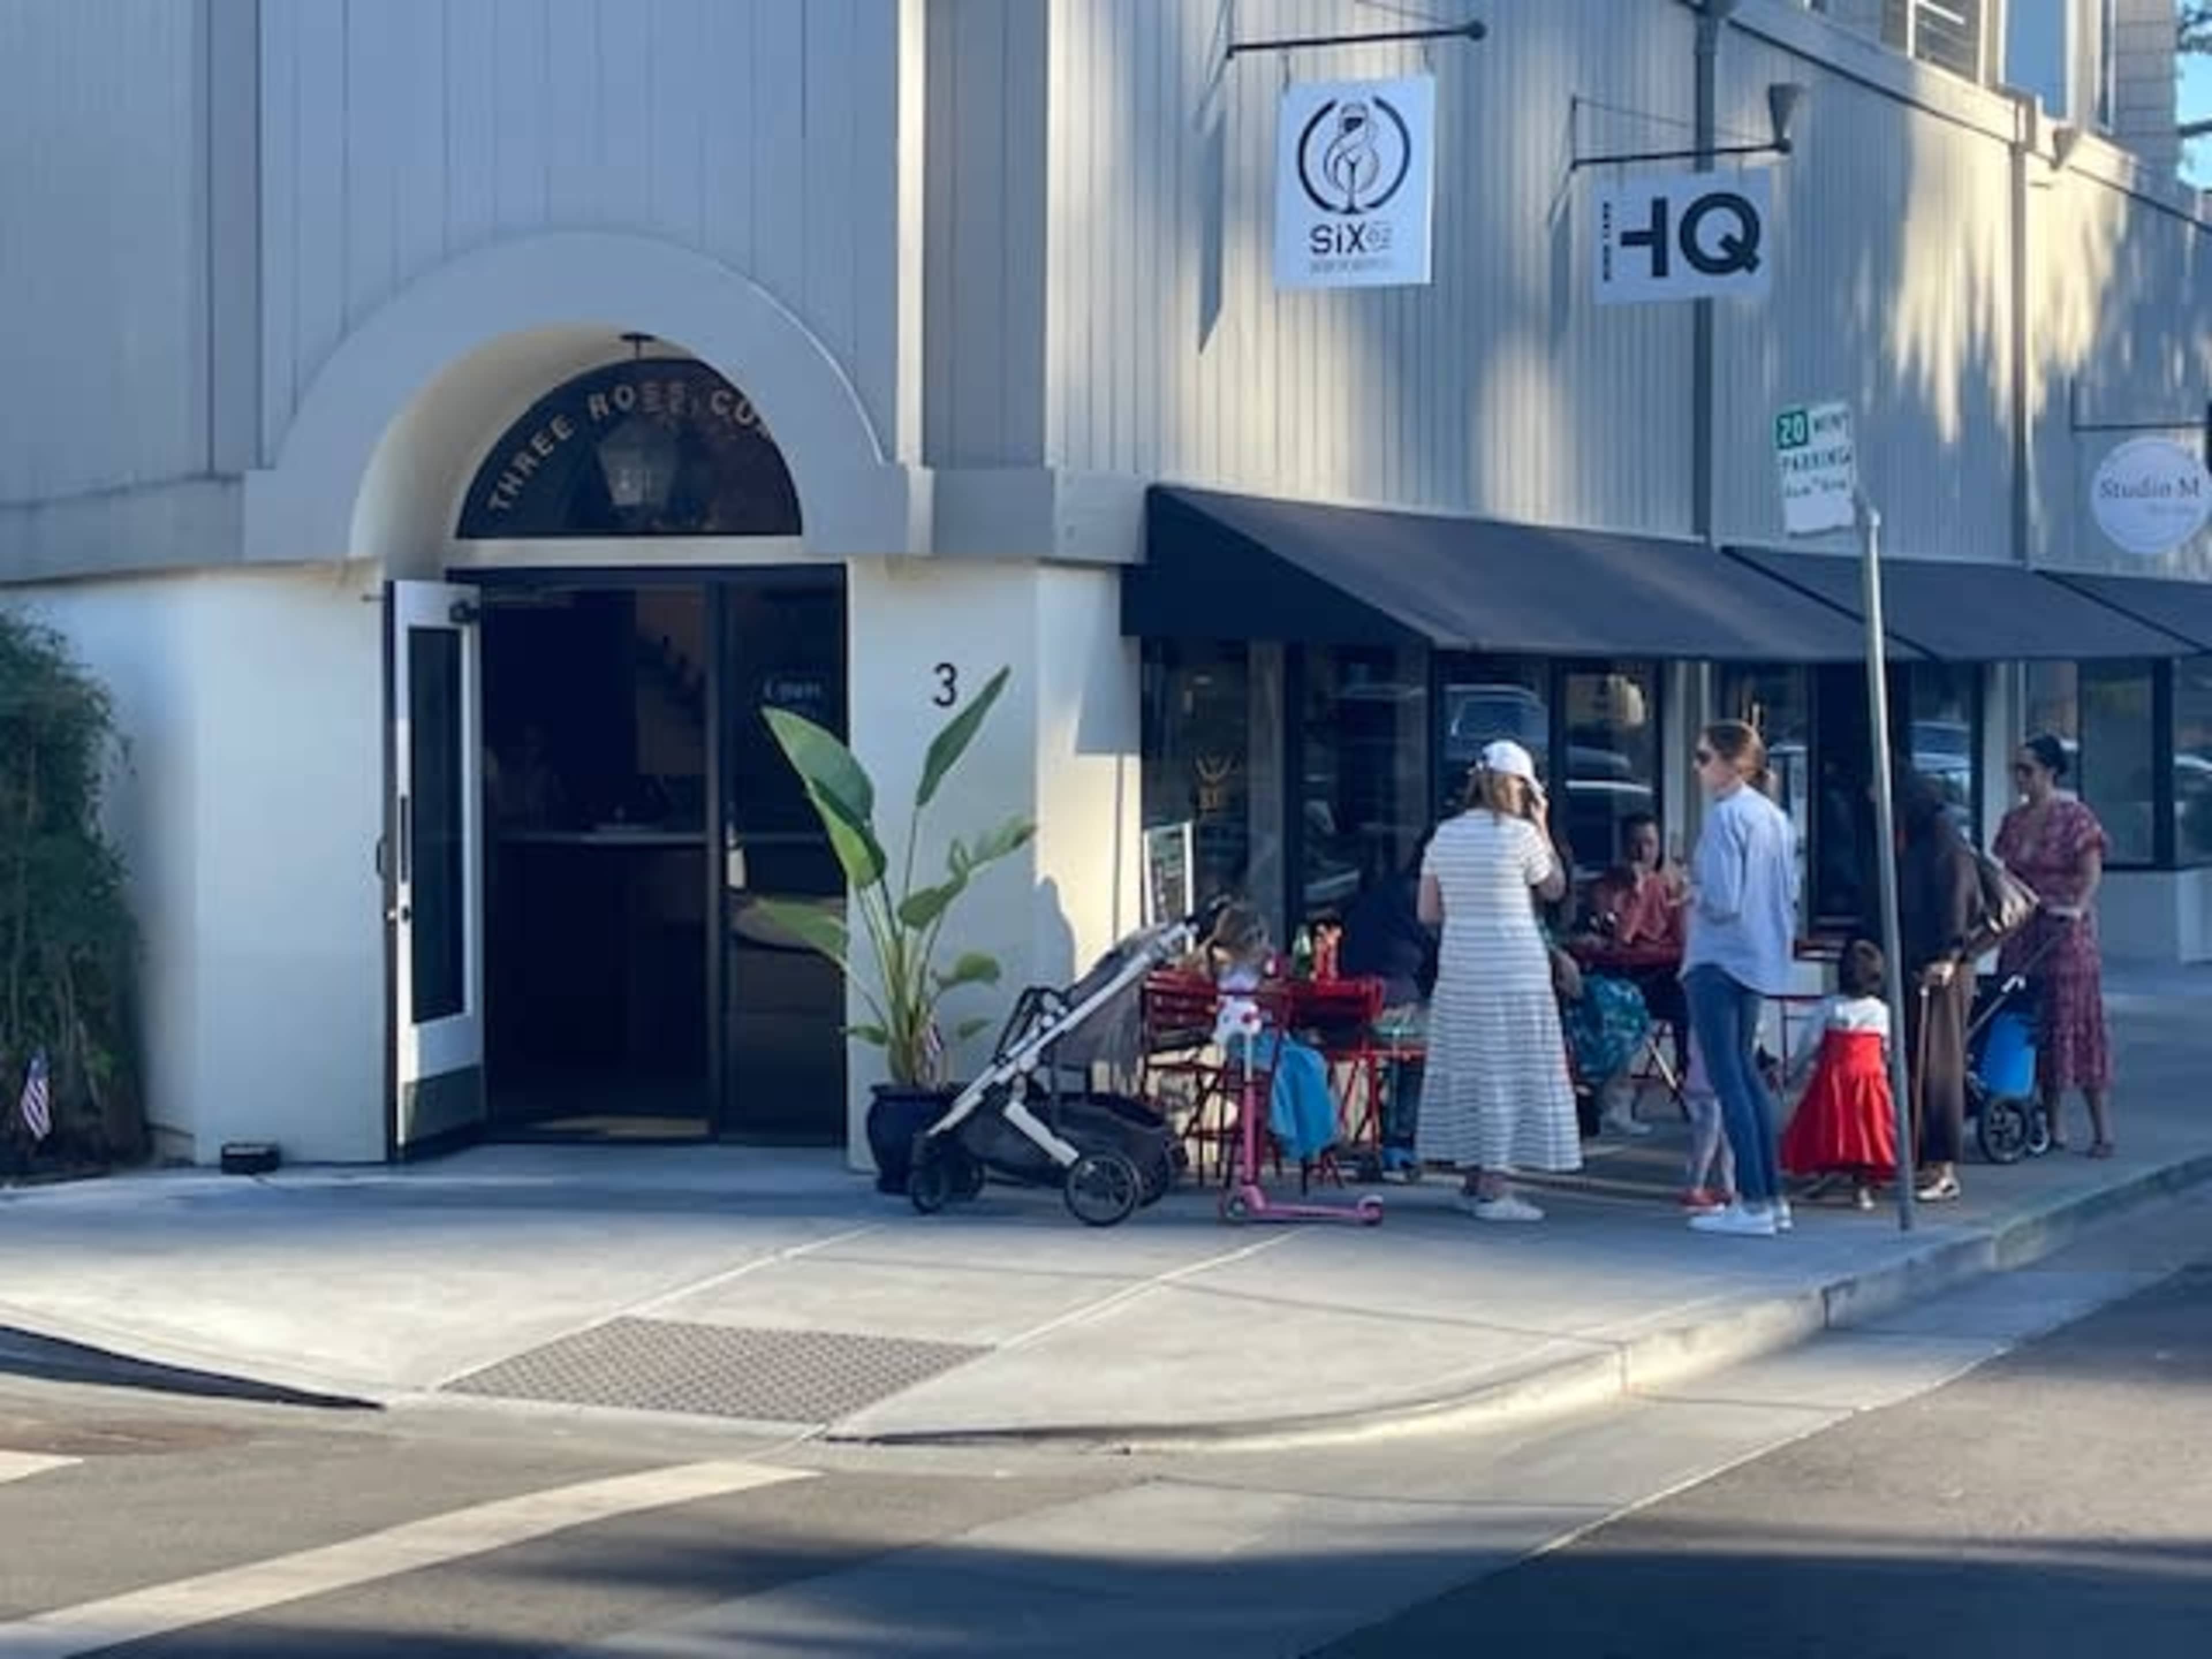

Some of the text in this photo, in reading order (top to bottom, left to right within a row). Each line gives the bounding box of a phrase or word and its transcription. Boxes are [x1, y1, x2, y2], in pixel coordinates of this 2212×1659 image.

[1619, 192, 1760, 277] HQ
[1779, 413, 1806, 445] 20
[487, 414, 575, 512] THREE
[2101, 474, 2200, 499] Studio M
[933, 662, 957, 708] 3
